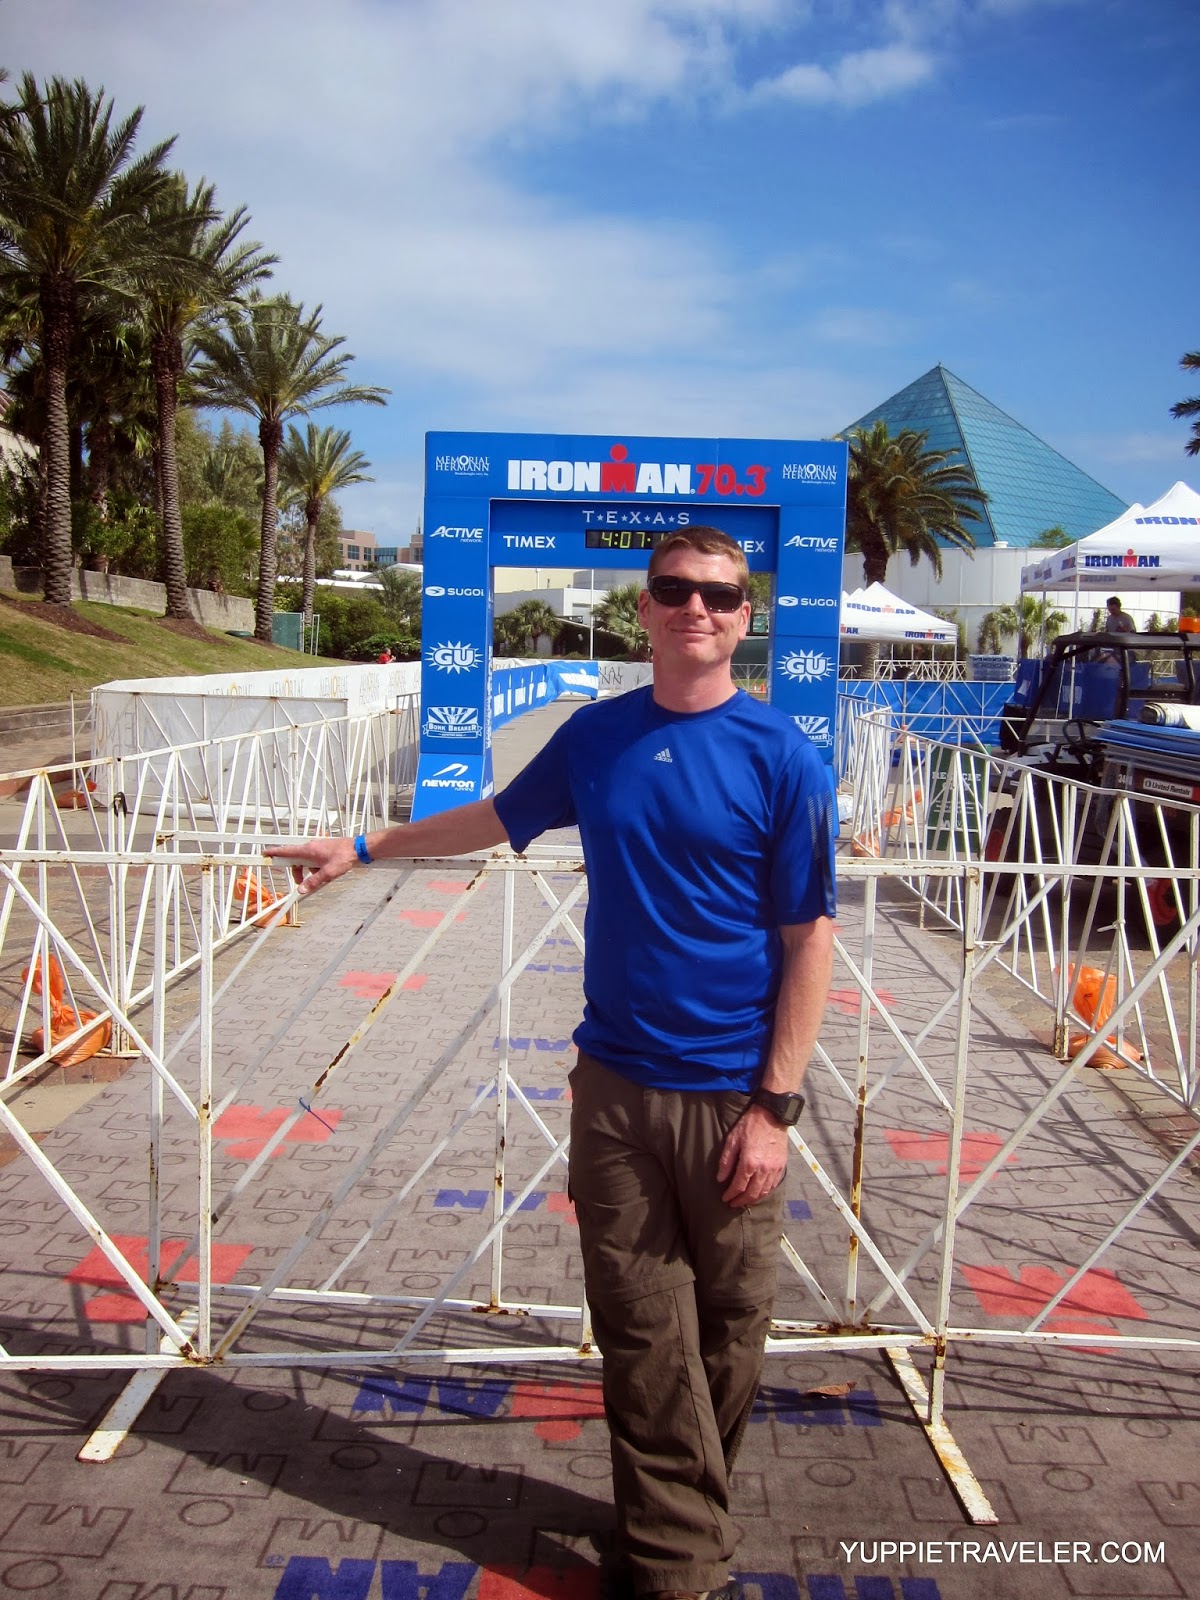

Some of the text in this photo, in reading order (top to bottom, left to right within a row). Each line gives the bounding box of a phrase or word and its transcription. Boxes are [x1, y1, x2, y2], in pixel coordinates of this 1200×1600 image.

[435, 455, 489, 465] MEMORIAL
[435, 463, 489, 471] HERMANN
[507, 444, 766, 497] IRONMAN 70.3
[783, 463, 838, 474] MEMORIAL
[782, 471, 837, 480] HERMANN
[430, 525, 484, 539] ACTIVE
[503, 535, 556, 549] TIMEX
[784, 535, 838, 548] ACTIVE
[1085, 549, 1160, 567] IRONMAN
[846, 603, 916, 615] IRONMAN
[905, 629, 946, 640] IRONMAN
[434, 651, 475, 666] GU
[786, 657, 827, 675] GU
[428, 723, 477, 732] BONK BREAKER
[653, 755, 673, 763] adidas
[1151, 782, 1191, 796] United Rentals
